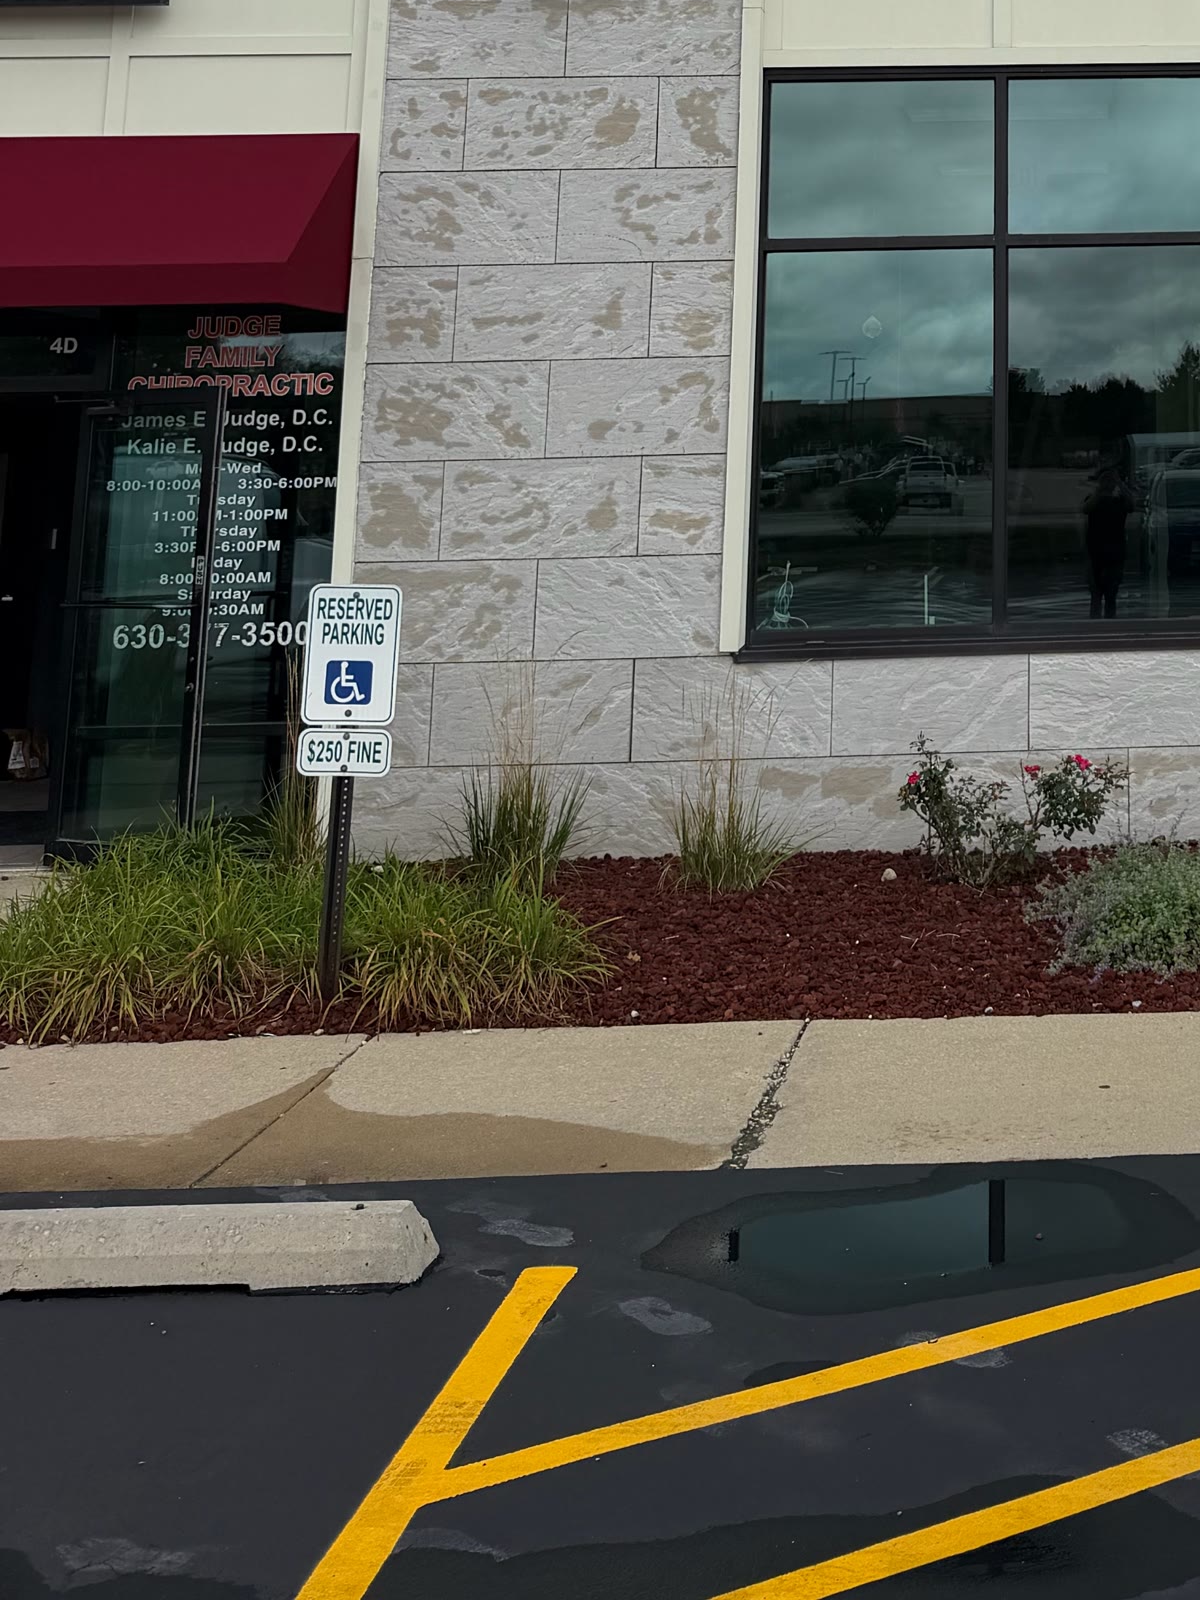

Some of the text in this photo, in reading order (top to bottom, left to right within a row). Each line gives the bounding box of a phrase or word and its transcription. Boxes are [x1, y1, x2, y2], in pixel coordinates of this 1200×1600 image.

[187, 315, 282, 339] JUDGE
[49, 337, 79, 354] 4D
[185, 345, 284, 369] FAMILY
[121, 411, 187, 429] James
[292, 409, 333, 427] D.C.
[127, 435, 324, 457] Kalie E. udge, D.C.
[185, 462, 262, 476] M-Wed
[106, 476, 338, 492] 8:00-10:00A 3:30-6:00PM
[186, 494, 257, 508] Tsday
[317, 597, 393, 621] RESERVED
[112, 621, 308, 650] 630-37-3500
[321, 622, 385, 646] PARKING
[307, 739, 383, 765] $250 FINE
